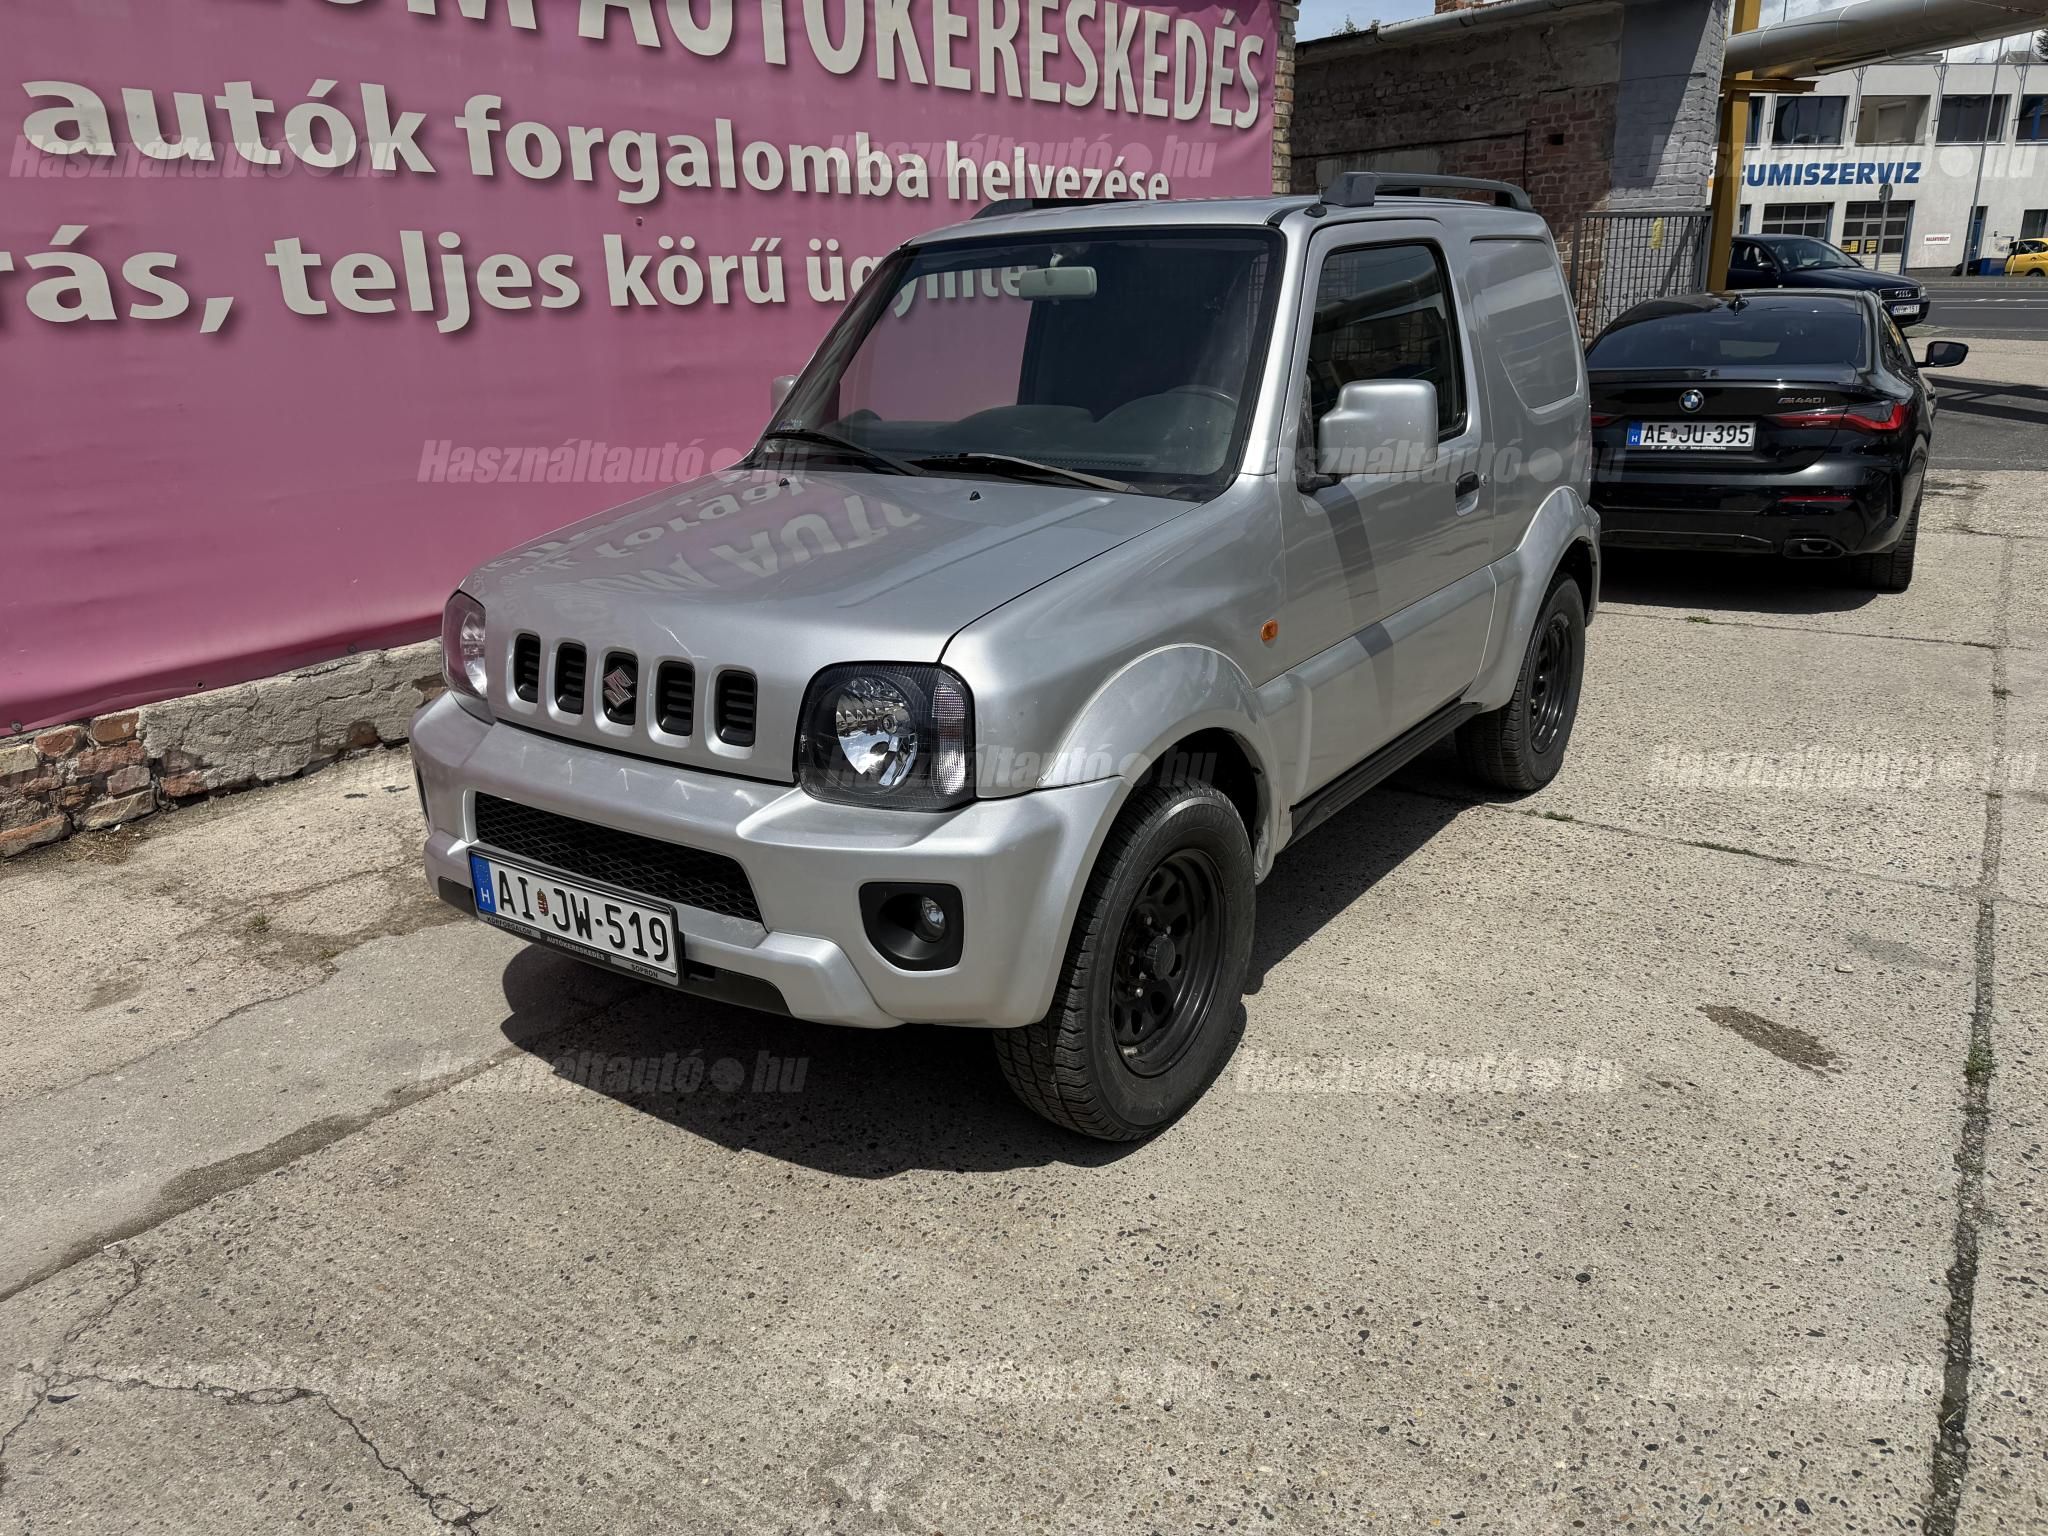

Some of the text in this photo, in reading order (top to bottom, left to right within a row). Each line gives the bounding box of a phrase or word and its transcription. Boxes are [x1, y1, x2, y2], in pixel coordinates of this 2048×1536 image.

[22, 79, 436, 173] autók
[455, 94, 929, 203] forgalomba
[1743, 162, 1922, 187] UMISZERVIZ
[0, 225, 234, 333] ás,
[265, 229, 580, 333] teljes
[603, 233, 785, 307] körű
[1643, 424, 1751, 444] AE JU-395
[498, 868, 669, 962] AI JW-519
